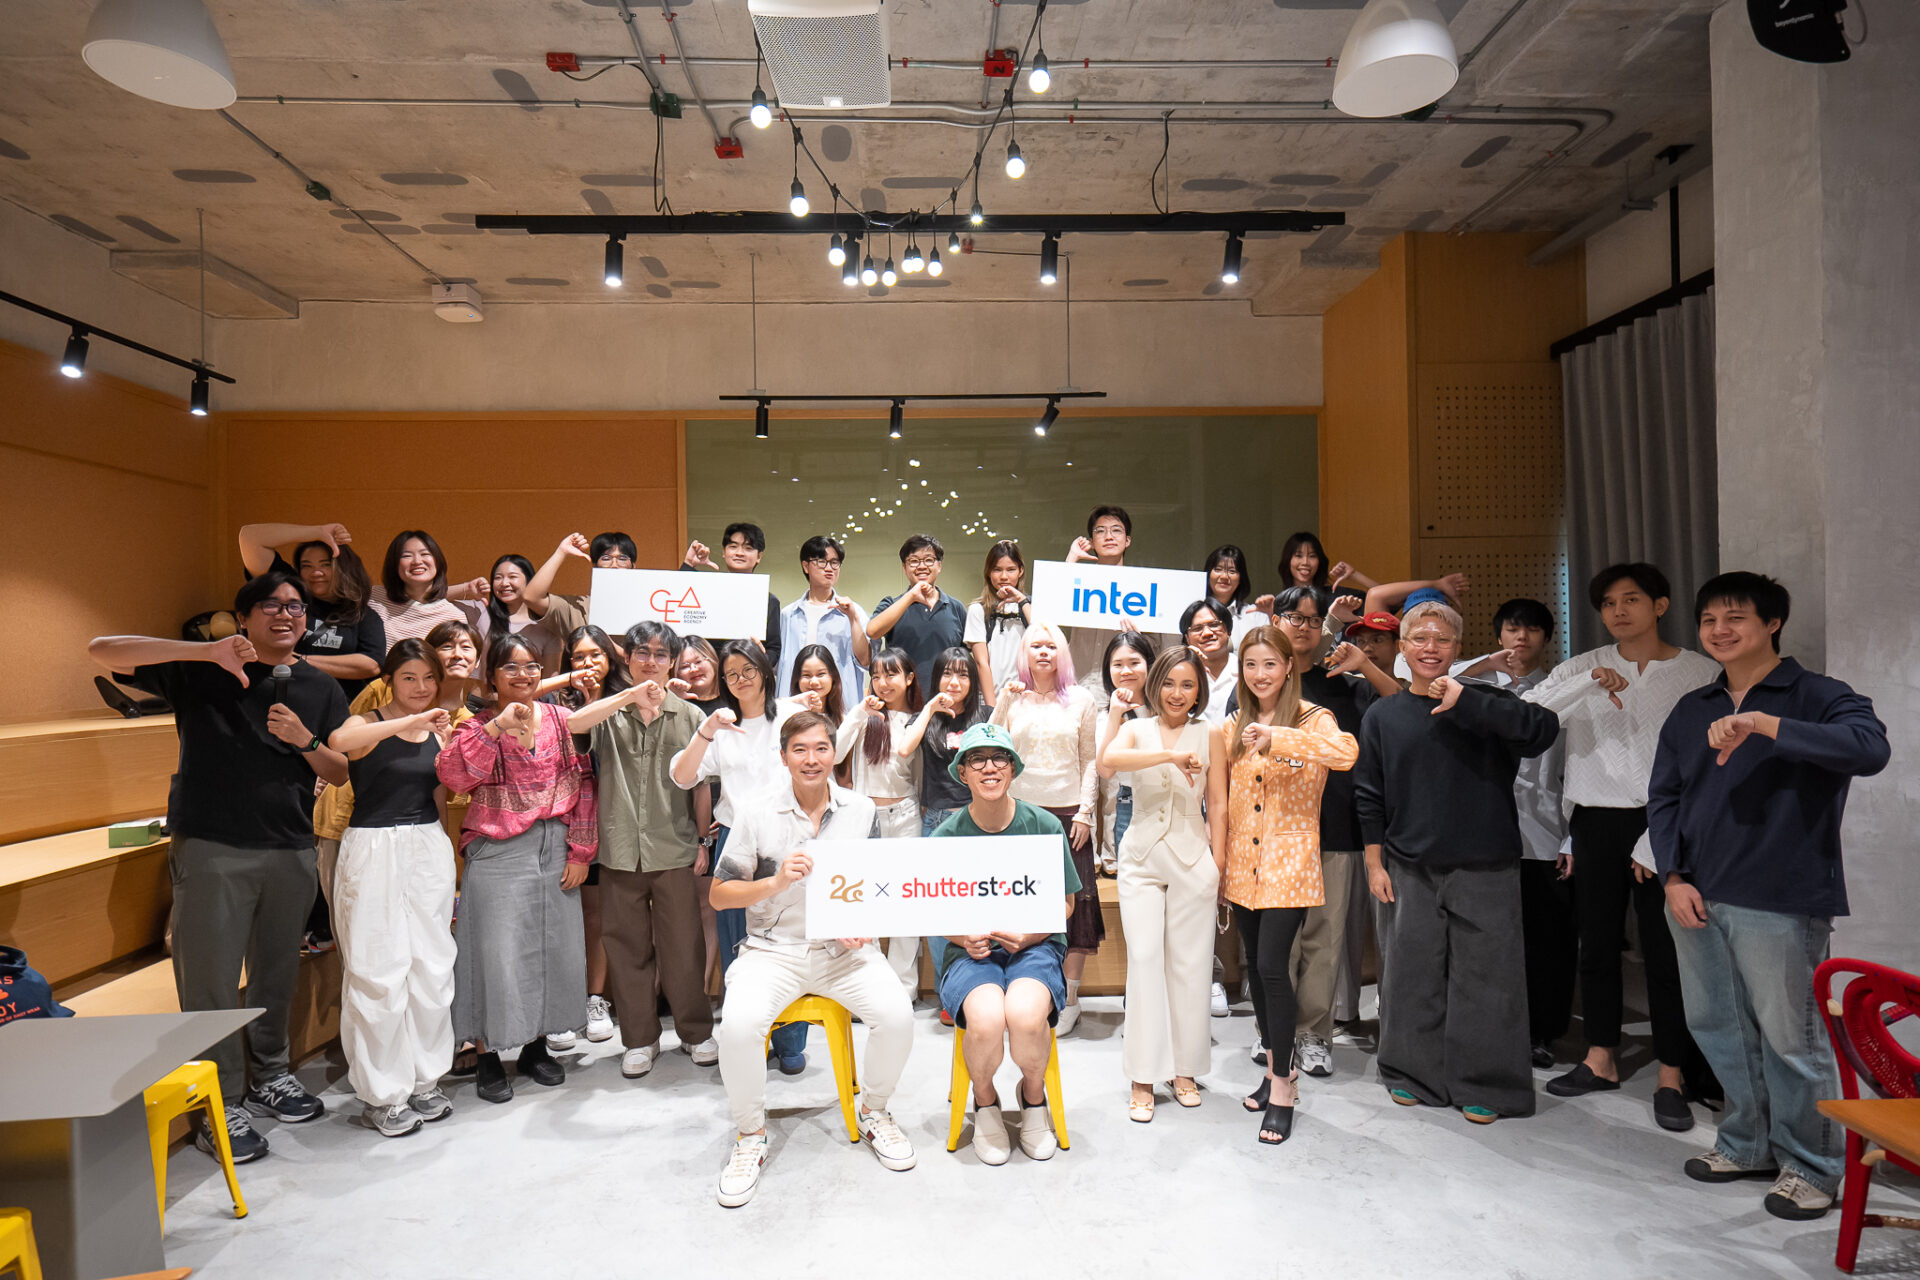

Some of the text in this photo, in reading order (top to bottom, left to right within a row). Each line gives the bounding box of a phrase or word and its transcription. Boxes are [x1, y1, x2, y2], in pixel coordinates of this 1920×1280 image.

[650, 586, 701, 622] CEA
[1072, 578, 1158, 617] intel
[902, 875, 1037, 898] shutterstock
